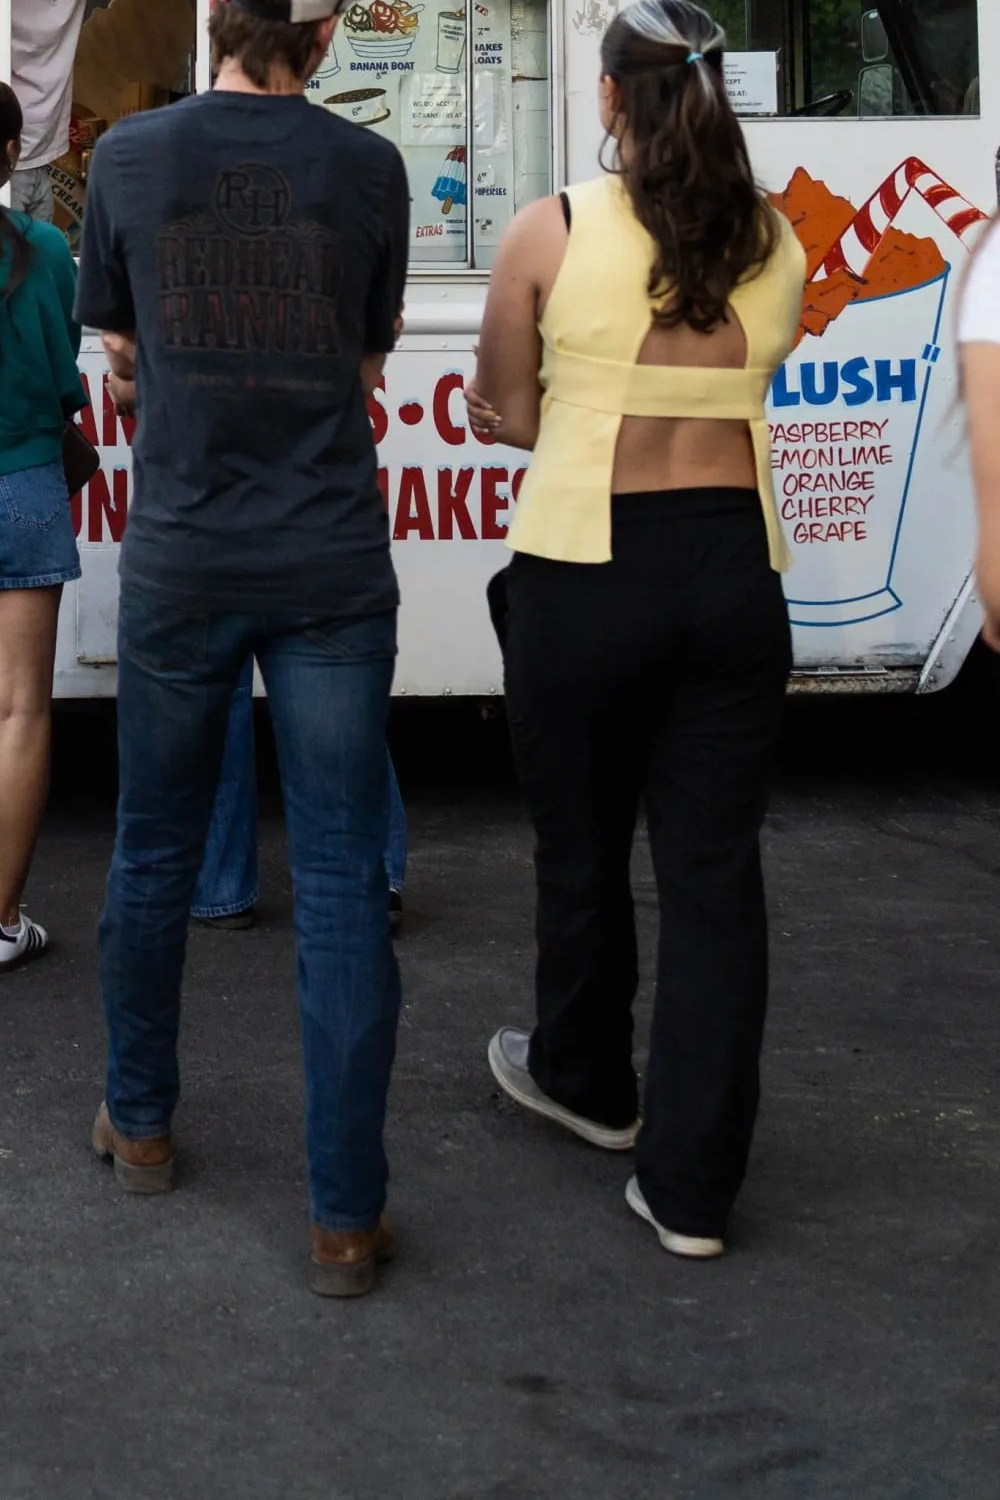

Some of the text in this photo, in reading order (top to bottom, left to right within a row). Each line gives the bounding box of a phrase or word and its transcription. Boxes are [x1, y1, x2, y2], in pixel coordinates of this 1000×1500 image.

[350, 61, 415, 71] BANANA BOAT
[416, 224, 443, 238] EXTRAS
[838, 445, 893, 467] LIME
[782, 471, 875, 497] ORANGE
[781, 494, 875, 520] CHERRY
[793, 521, 868, 544] GRAPE
